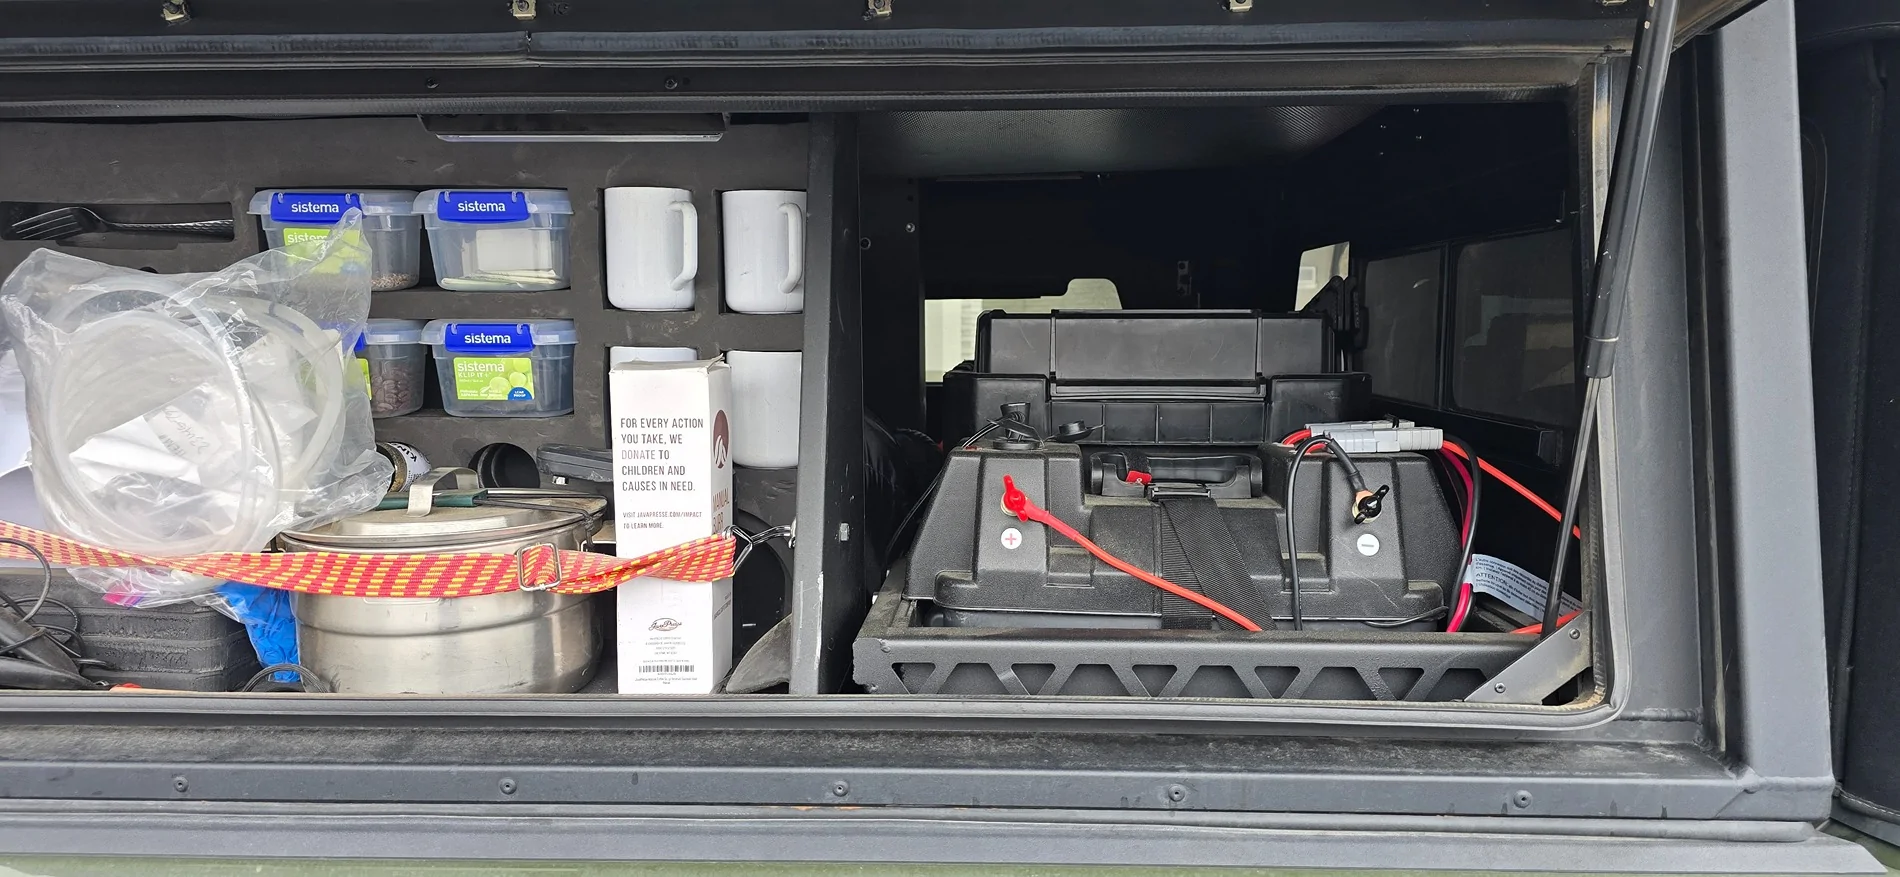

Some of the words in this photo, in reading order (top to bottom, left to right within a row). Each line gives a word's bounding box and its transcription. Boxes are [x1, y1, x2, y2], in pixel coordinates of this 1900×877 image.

[291, 201, 340, 213] sistema
[457, 200, 506, 212] sistema
[464, 333, 512, 344] sistema
[457, 361, 505, 372] sistema
[620, 417, 638, 429] FOR
[640, 418, 669, 429] EVERY
[671, 418, 704, 429] ACTION
[621, 434, 639, 444] YOU
[641, 433, 667, 445] TAKE,
[669, 434, 683, 445] WE
[621, 449, 656, 460] DONATE
[658, 449, 670, 460] TO
[621, 465, 665, 476] CHILDREN
[667, 465, 686, 476] AND
[622, 481, 657, 491] CAUSES
[659, 481, 668, 491] IN
[670, 481, 695, 491] NEED.
